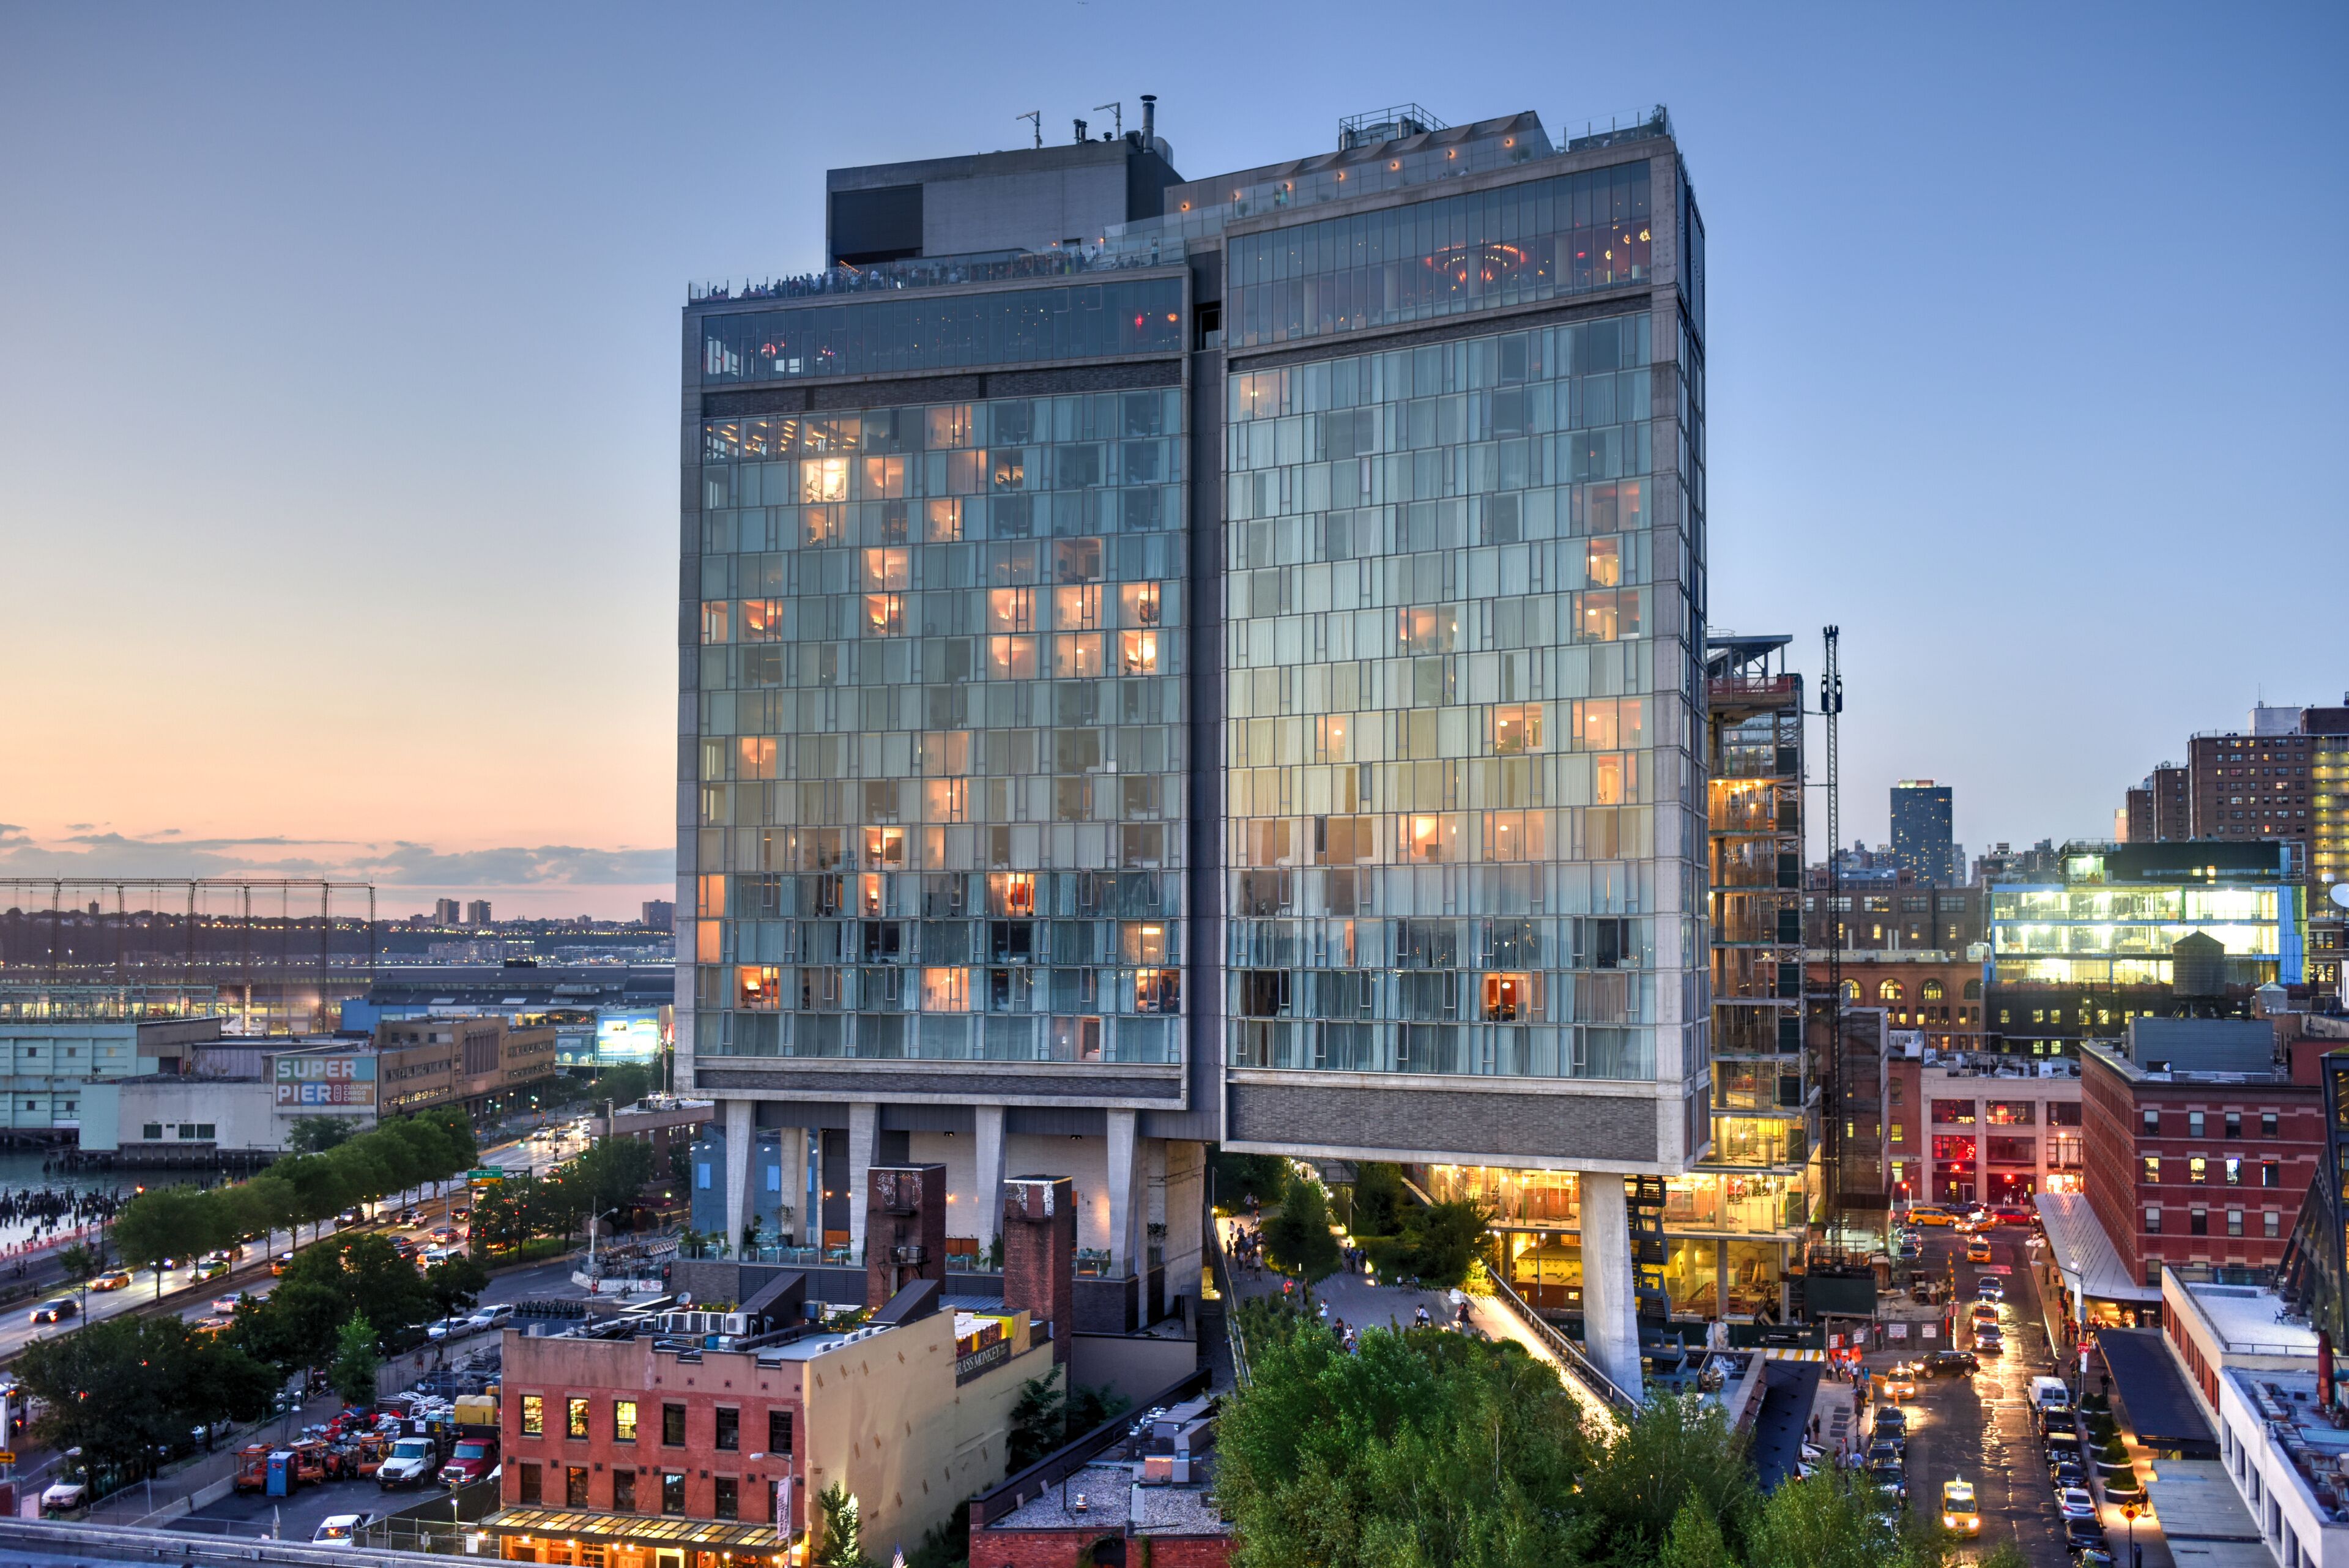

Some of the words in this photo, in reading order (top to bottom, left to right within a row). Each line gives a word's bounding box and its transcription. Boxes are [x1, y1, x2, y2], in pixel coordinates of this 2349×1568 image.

[278, 1061, 357, 1078] SUPER
[278, 1085, 332, 1102] PIER
[974, 1345, 1000, 1368] MONKEY
